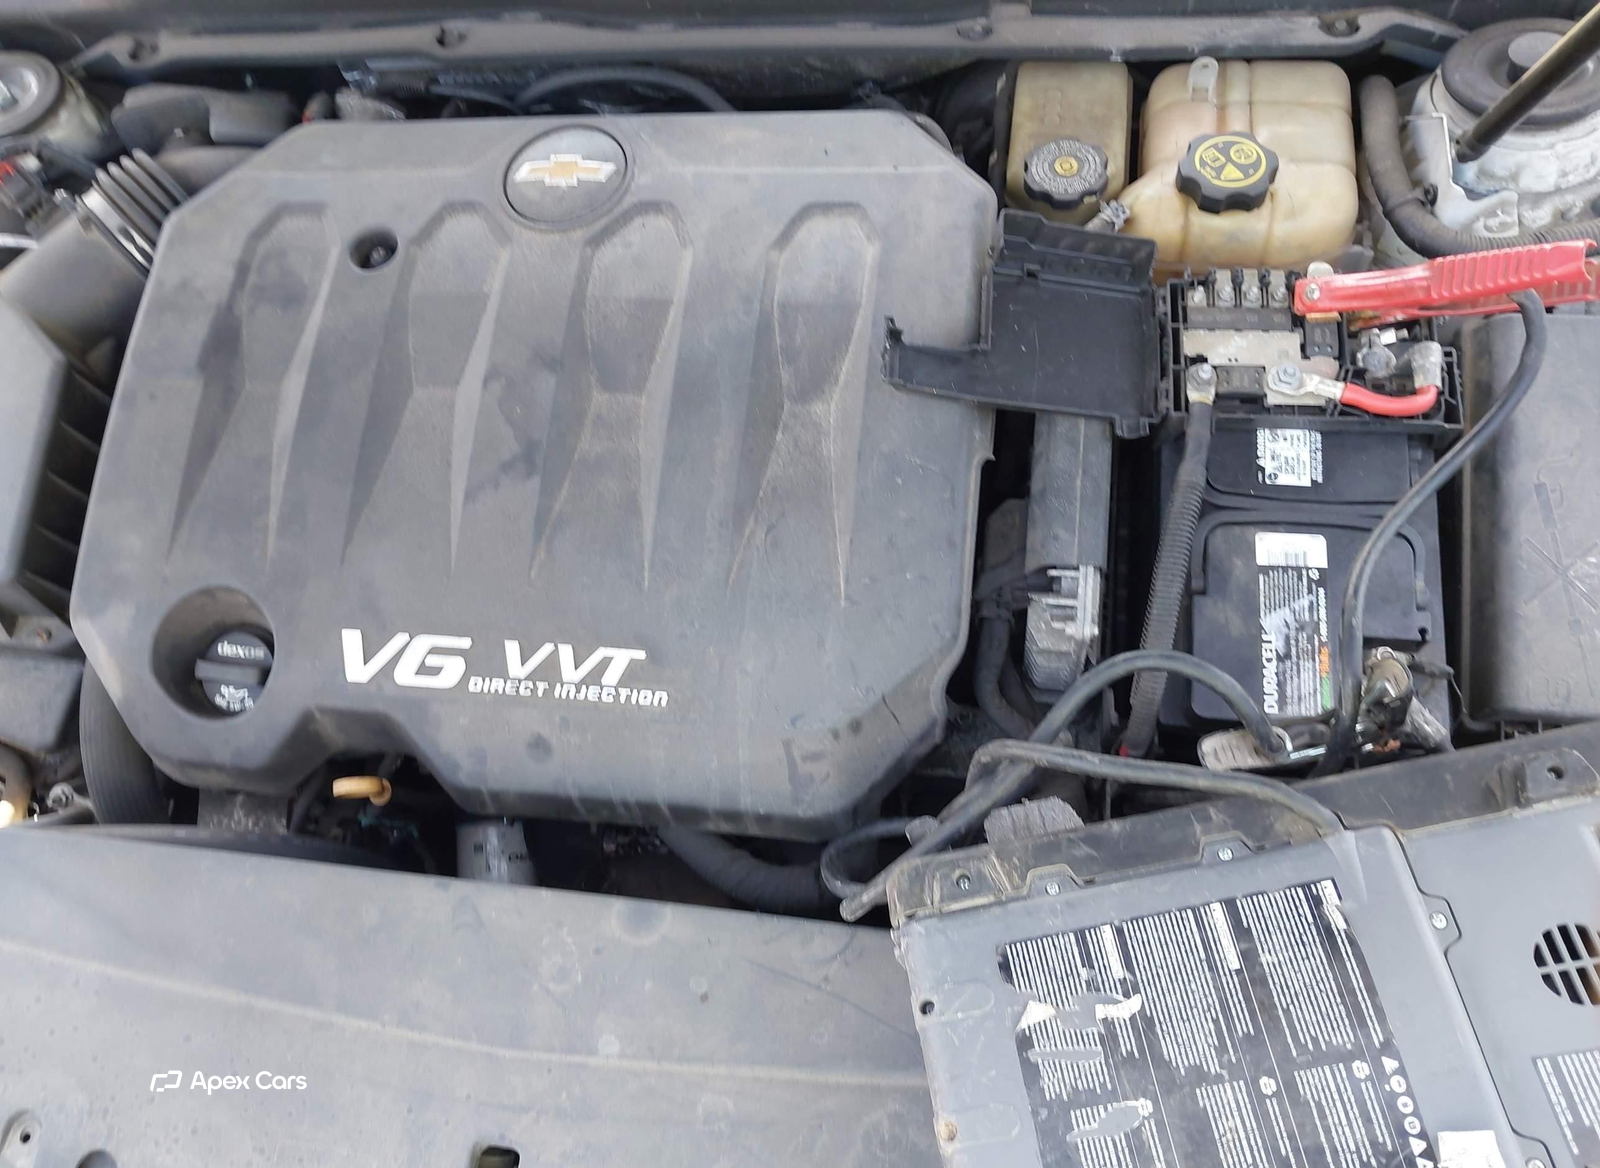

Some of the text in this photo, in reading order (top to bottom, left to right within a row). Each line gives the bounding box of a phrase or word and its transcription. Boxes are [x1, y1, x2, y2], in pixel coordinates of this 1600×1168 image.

[217, 640, 265, 660] dexos
[341, 628, 647, 689] V6 VVT
[1261, 629, 1279, 715] DURACELL
[467, 676, 668, 707] DIRECT INJECTION
